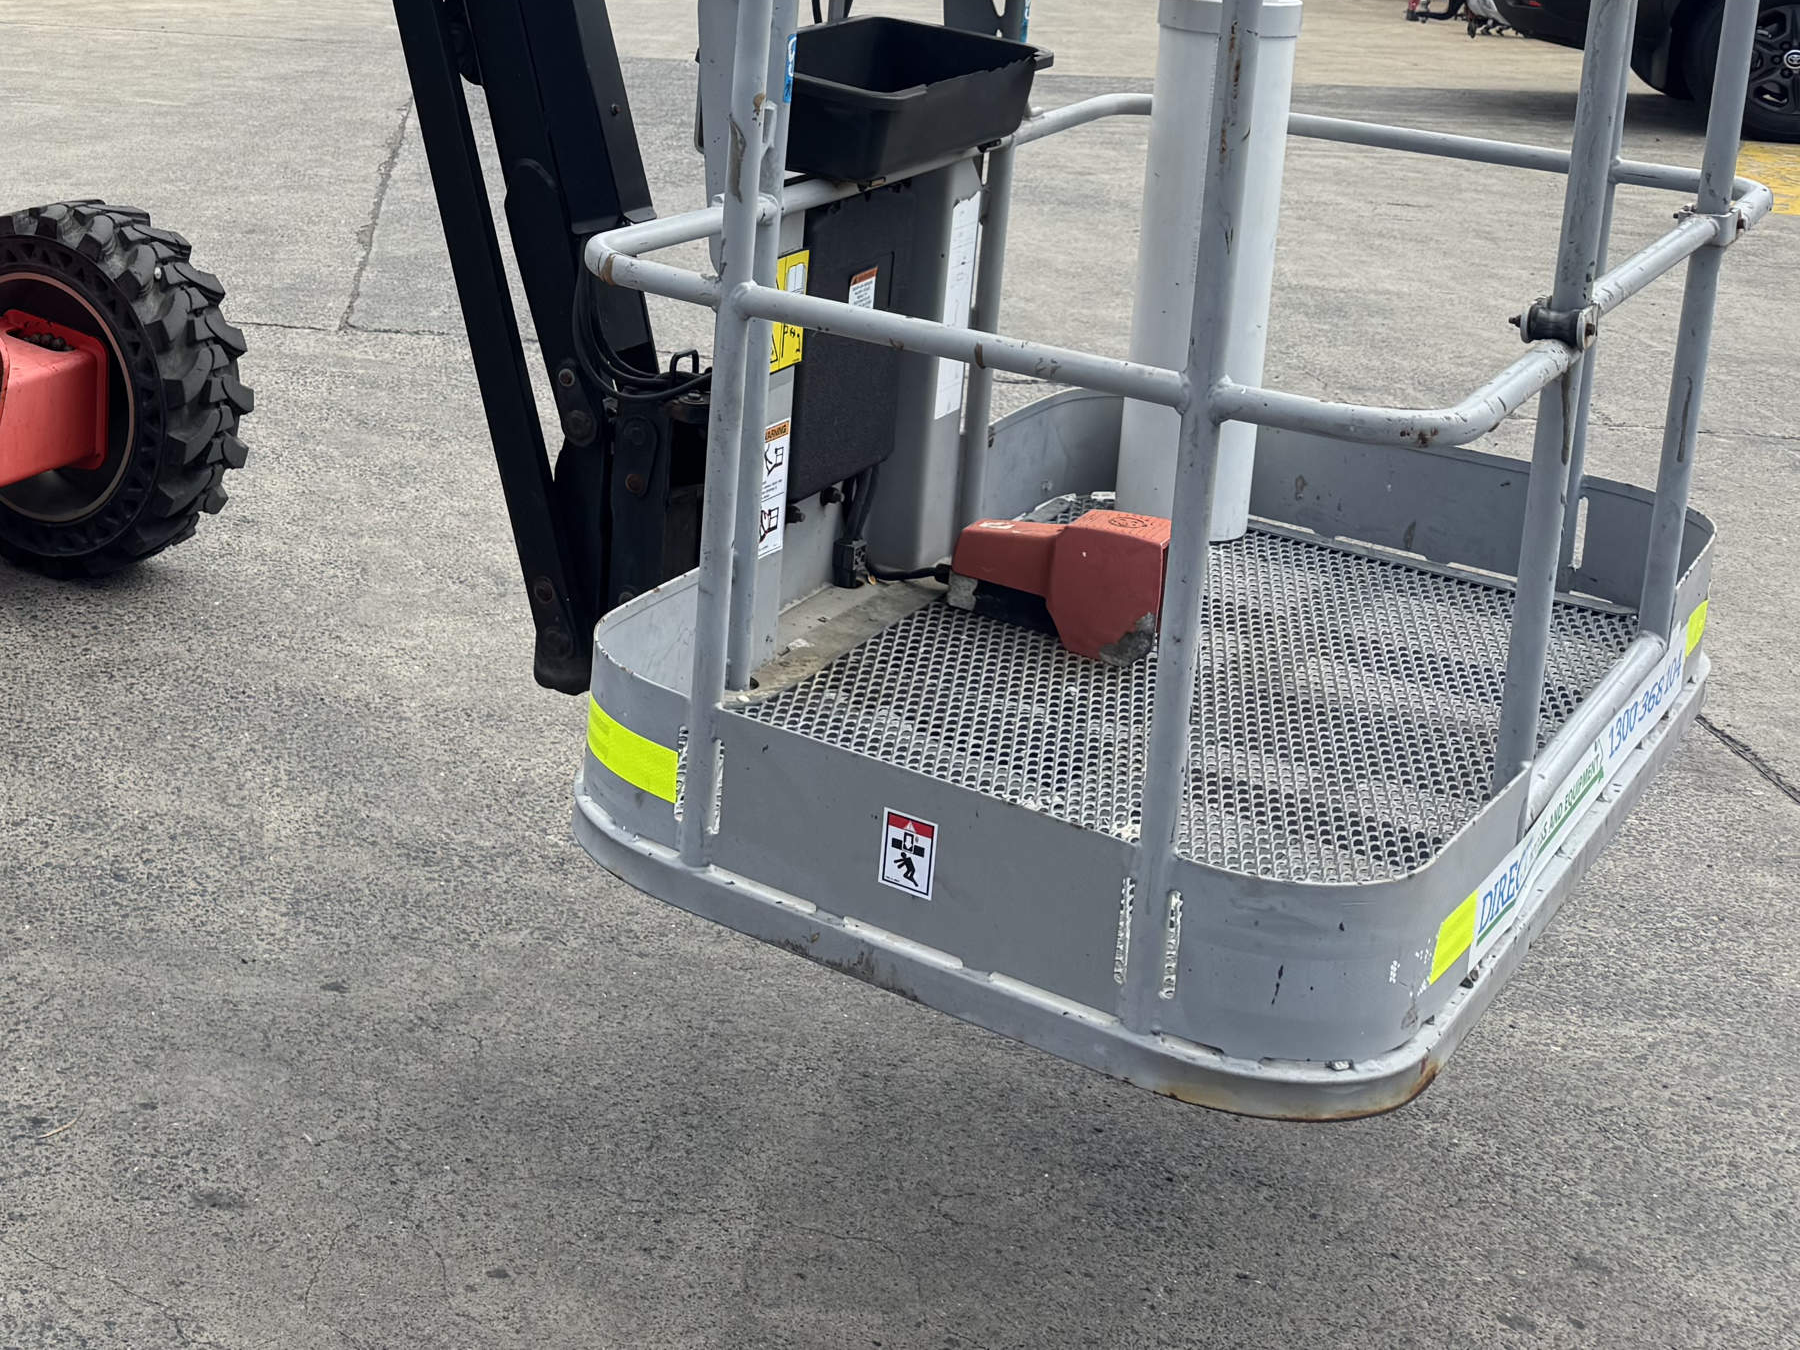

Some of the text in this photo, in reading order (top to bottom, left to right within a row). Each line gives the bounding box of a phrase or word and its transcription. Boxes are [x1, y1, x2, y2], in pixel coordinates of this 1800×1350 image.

[765, 423, 787, 441] ARNING
[1609, 649, 1683, 759] 1300 368 104
[1478, 838, 1534, 935] DIREC
